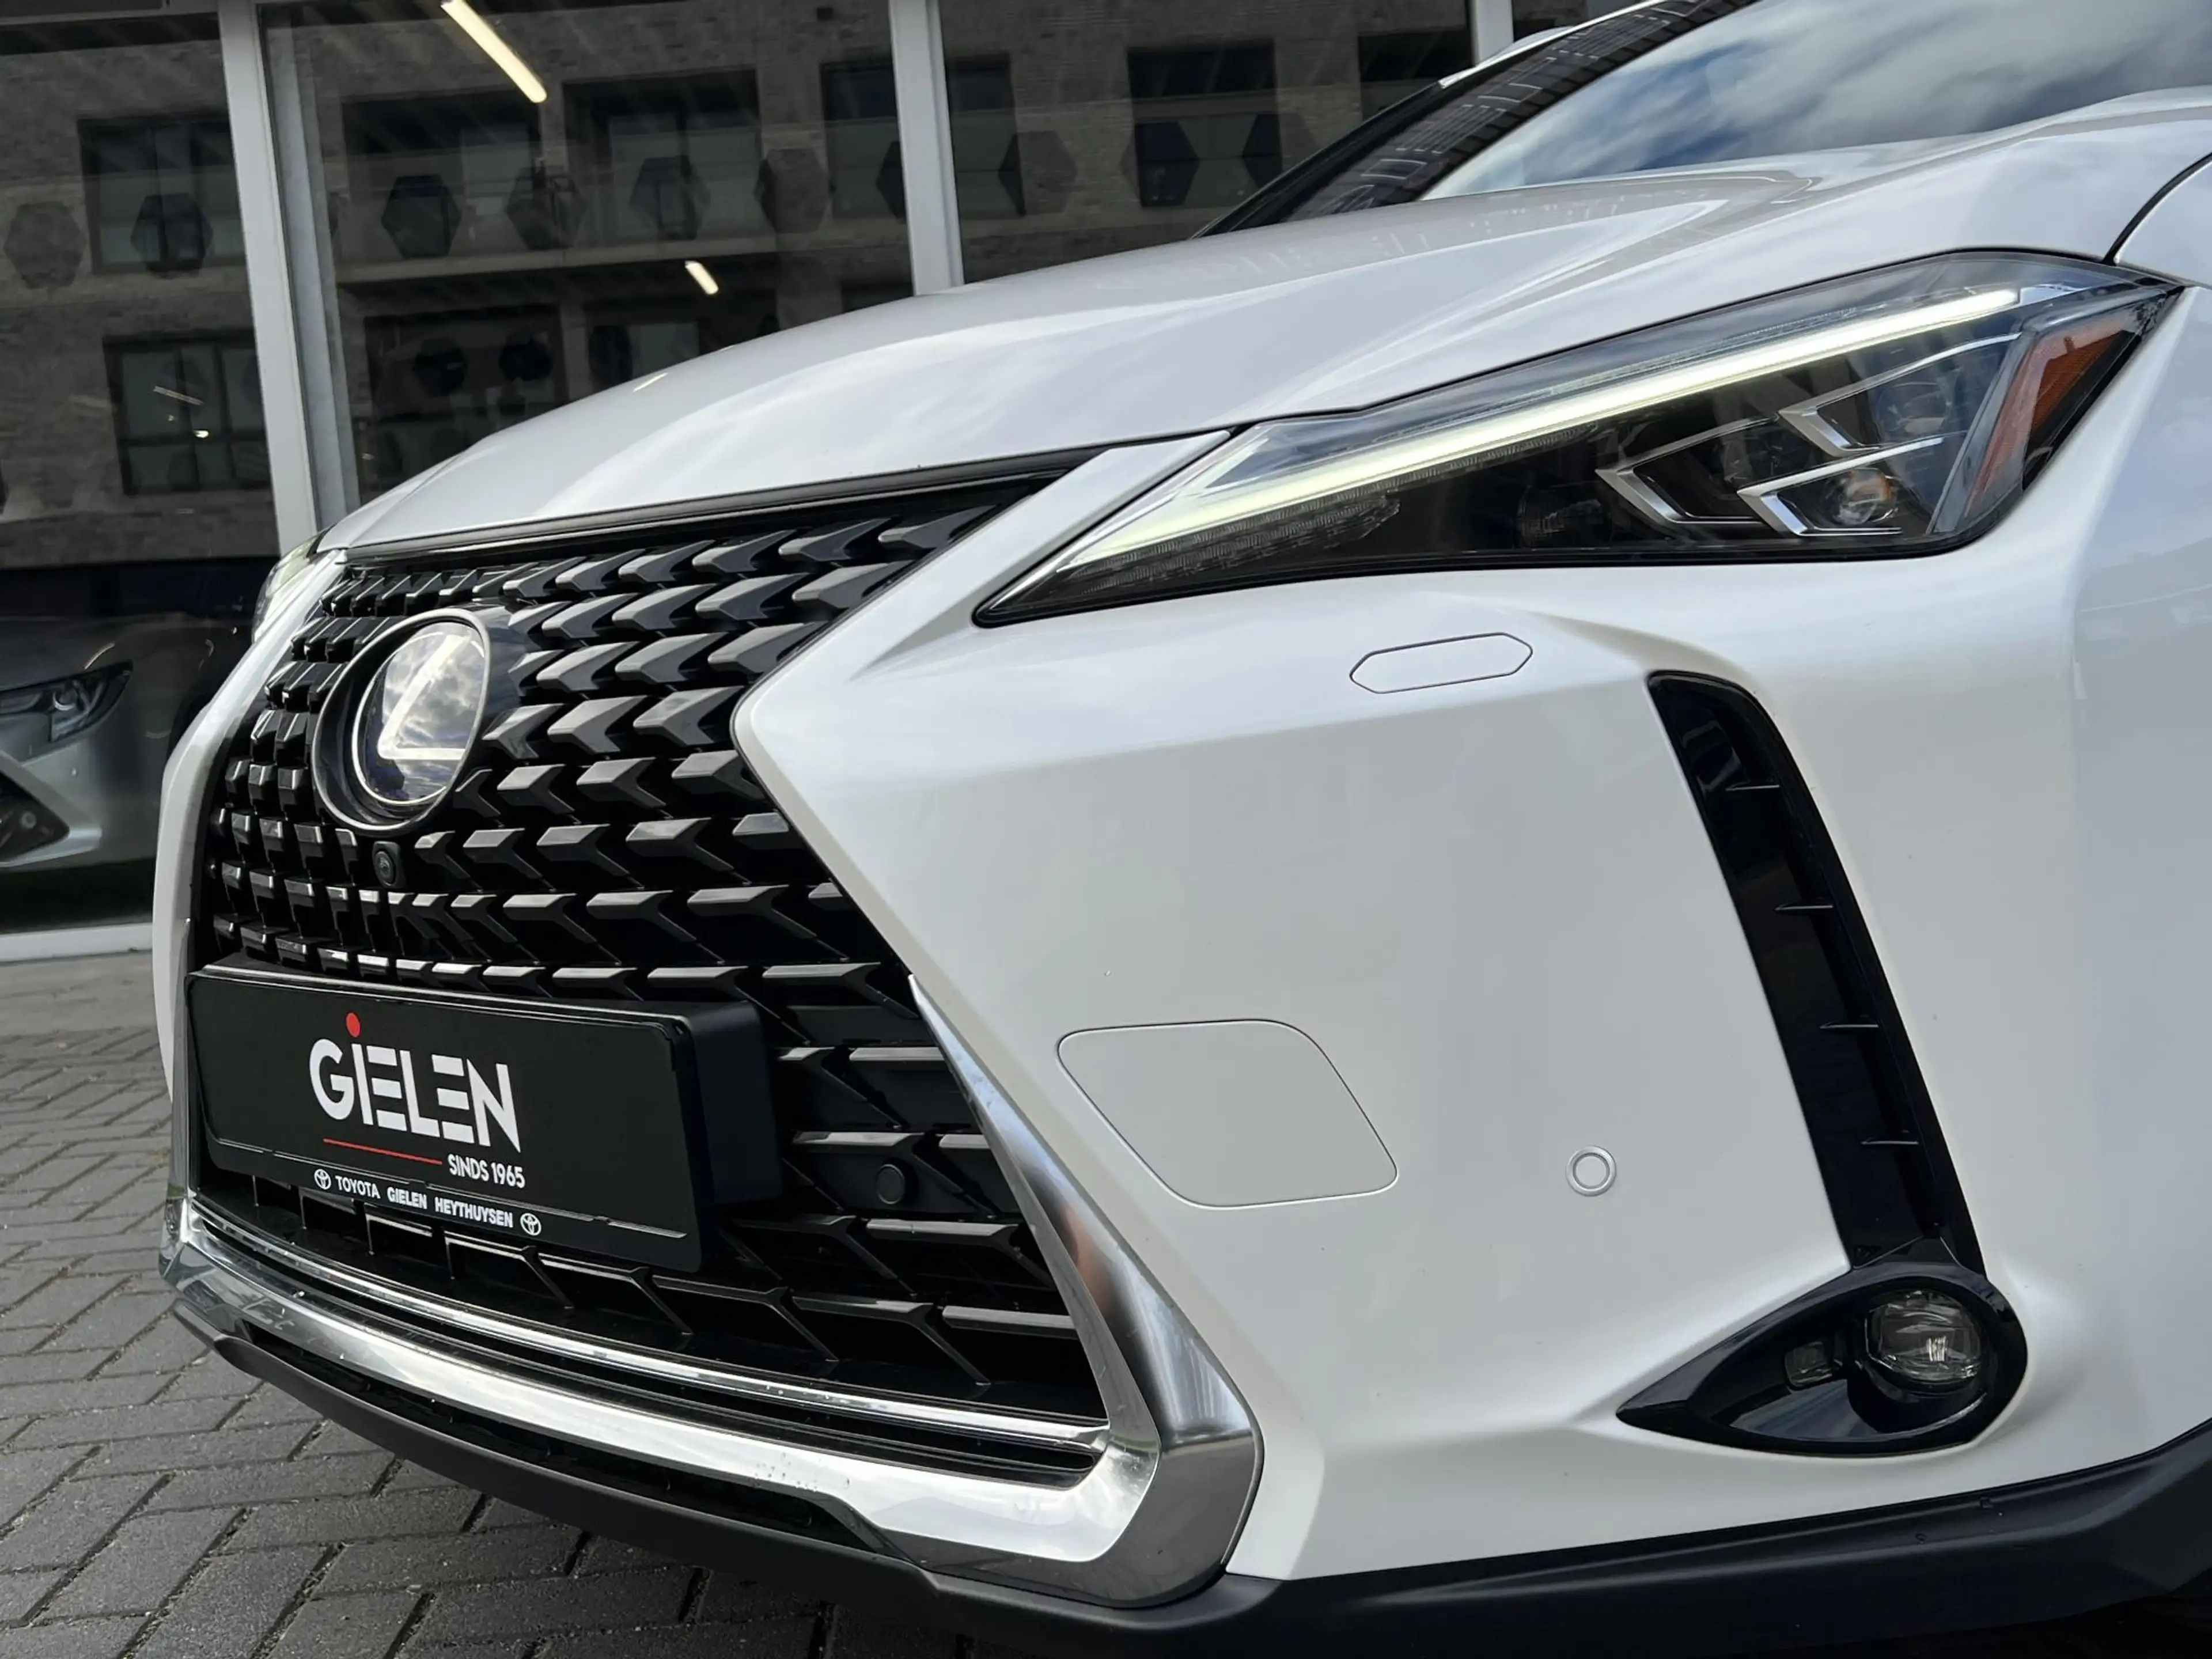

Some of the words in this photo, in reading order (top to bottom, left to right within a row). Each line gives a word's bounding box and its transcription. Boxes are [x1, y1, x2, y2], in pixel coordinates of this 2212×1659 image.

[448, 1153, 490, 1182] SINDS
[490, 1162, 526, 1189] 1965
[335, 1175, 381, 1199] TOYOTA
[387, 1187, 427, 1210] GIELEN
[434, 1196, 514, 1229] HEYTHUYSEN
